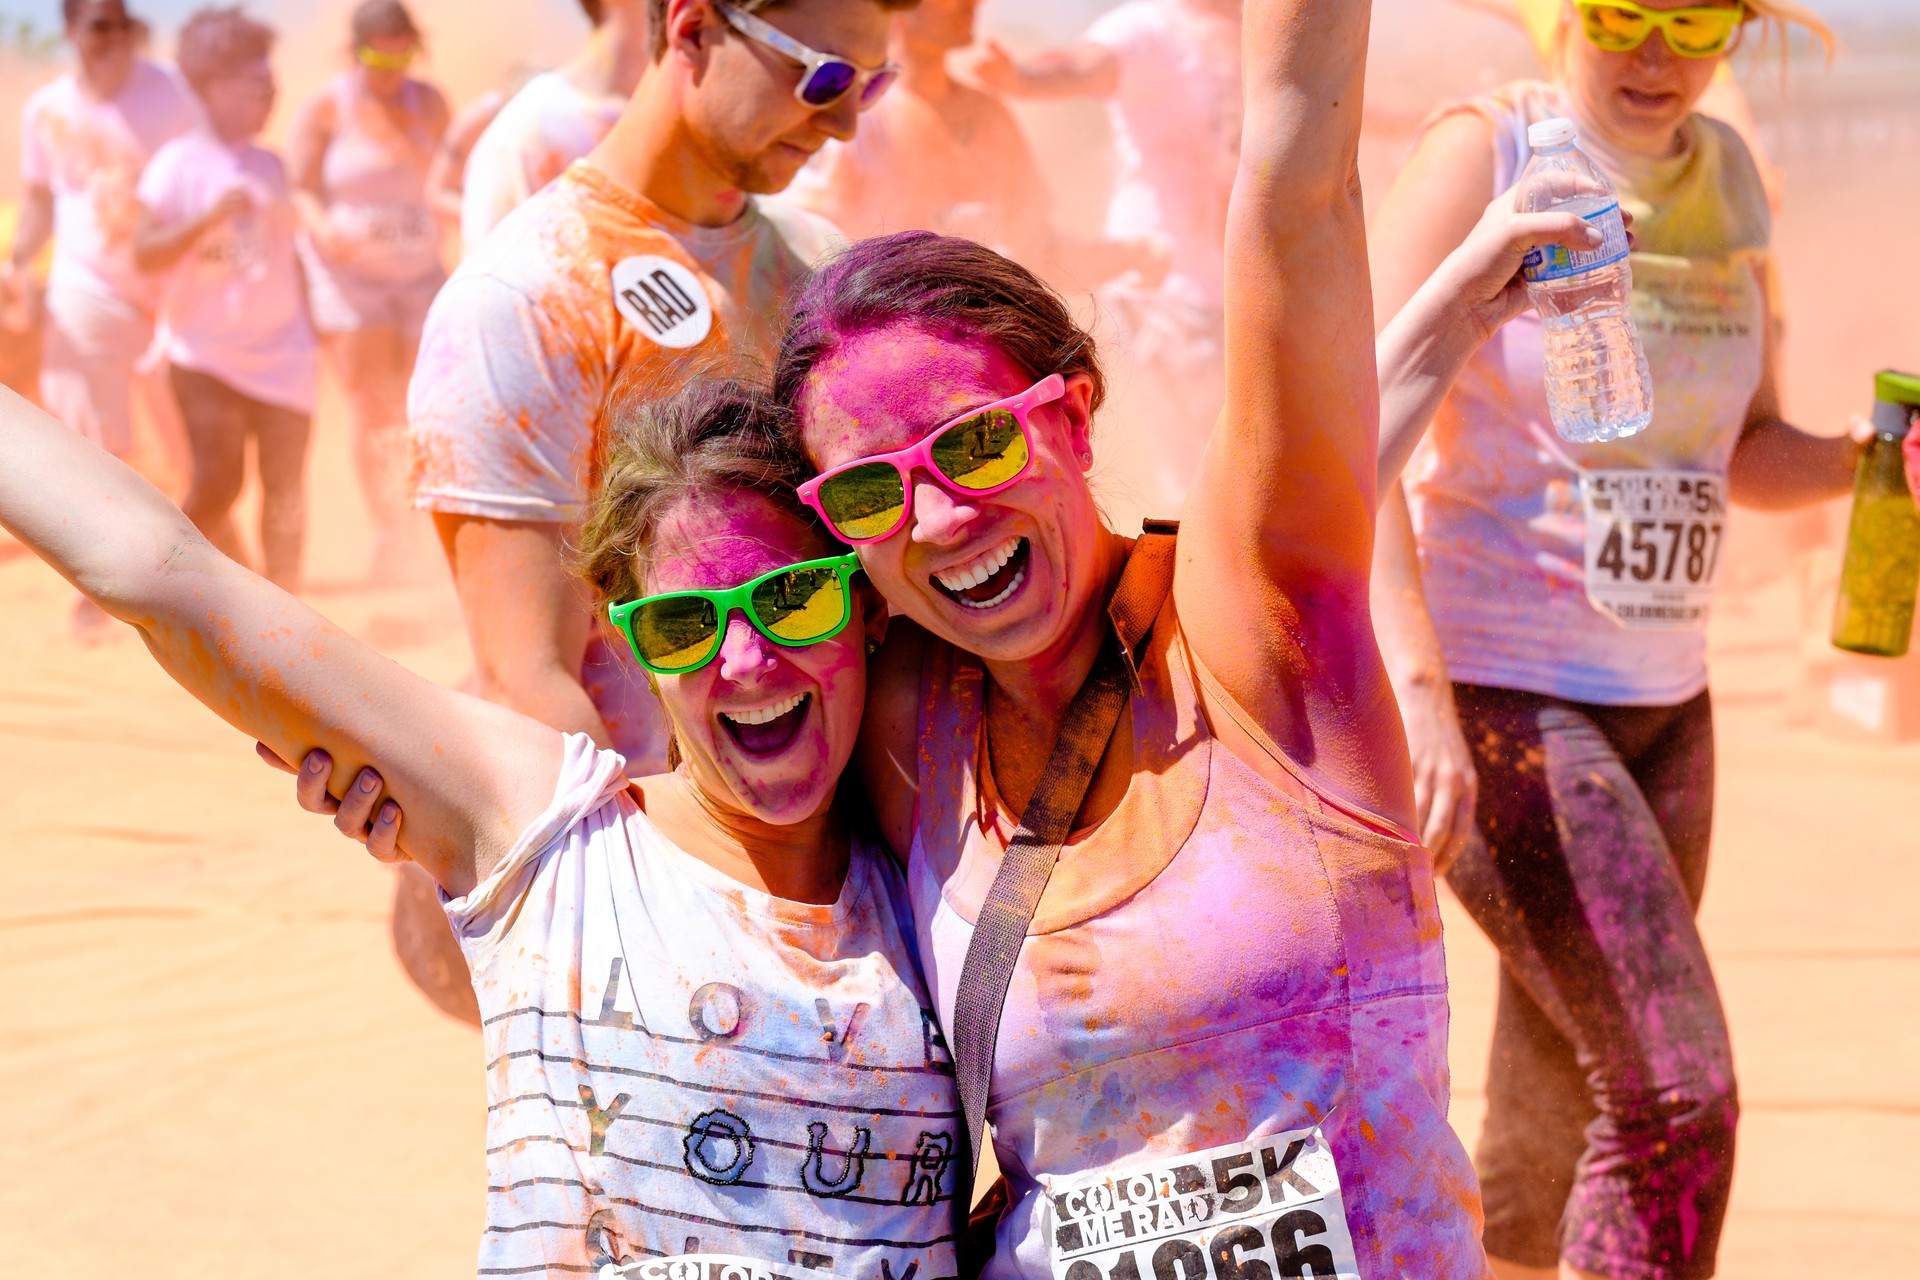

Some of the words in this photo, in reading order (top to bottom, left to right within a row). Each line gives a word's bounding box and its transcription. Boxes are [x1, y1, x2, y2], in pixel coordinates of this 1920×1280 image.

[621, 269, 697, 336] RAD
[1597, 521, 1723, 582] 45787
[577, 1083, 953, 1206] YOUR
[1065, 1169, 1181, 1221] COLOR
[1211, 1138, 1321, 1214] 5K
